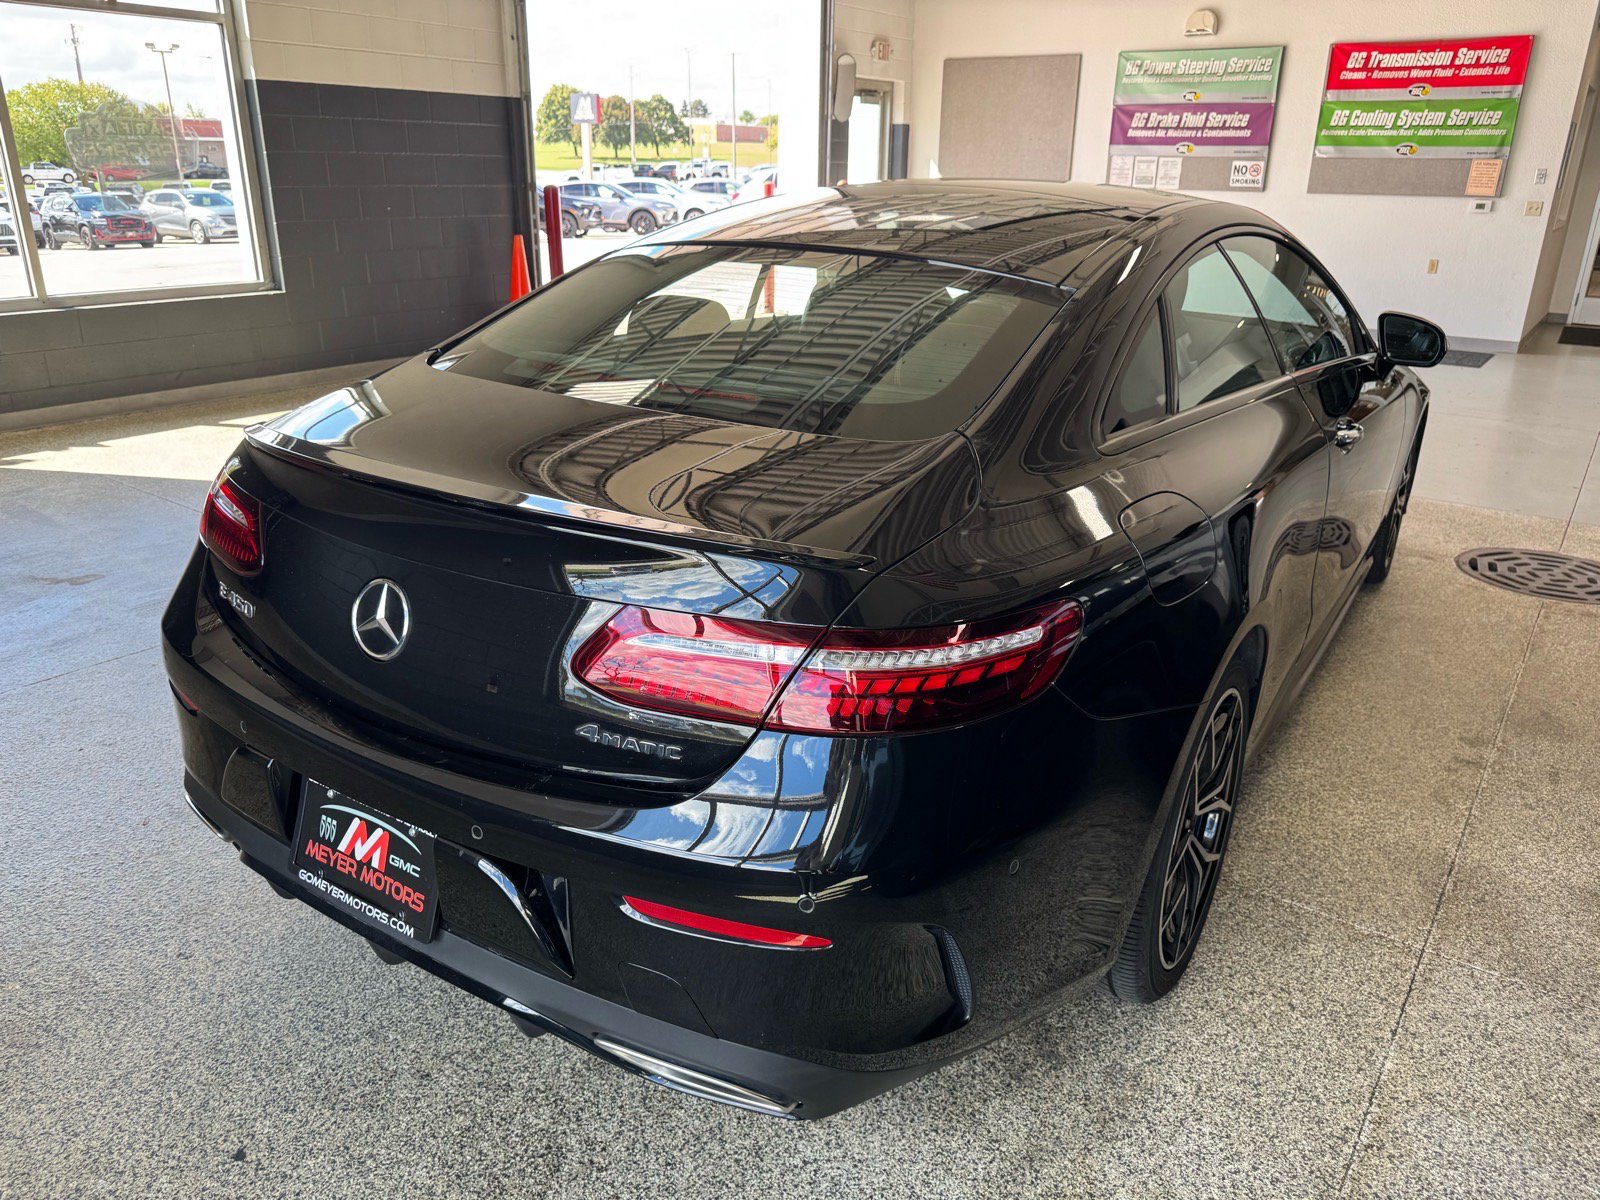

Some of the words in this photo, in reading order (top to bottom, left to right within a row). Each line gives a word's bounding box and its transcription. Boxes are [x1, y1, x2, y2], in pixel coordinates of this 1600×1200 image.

[1125, 60, 1141, 75] BG
[1140, 60, 1176, 75] Power
[1176, 58, 1227, 77] Steering
[1227, 56, 1273, 73] Service
[1346, 51, 1367, 68] BG
[1367, 49, 1454, 68] Transmission
[1454, 46, 1511, 65] Service
[1339, 70, 1367, 79] Cleans
[1371, 69, 1409, 79] Removes
[1409, 68, 1433, 78] Worn
[1432, 67, 1455, 77] Fluid
[1459, 67, 1493, 76] Extends
[1493, 65, 1511, 75] Life
[1131, 112, 1148, 127] BG
[1147, 112, 1180, 127] Brake
[1181, 112, 1206, 127] Fluid
[1206, 111, 1250, 127] Service
[1329, 110, 1350, 126] BG
[1349, 109, 1397, 129] Cooling
[1397, 109, 1447, 129] System
[1447, 108, 1503, 126] Service
[1127, 129, 1155, 137] Removes
[1167, 129, 1196, 137] Moisture
[1202, 129, 1252, 137] Contaminants
[1321, 128, 1348, 136] Removes
[1417, 128, 1434, 136] Adds
[1434, 128, 1464, 136] Premium
[1464, 128, 1506, 136] Conditioners
[1233, 165, 1248, 176] NO
[575, 723, 683, 760] 4MATIC
[305, 839, 358, 879] MEYER
[359, 865, 425, 913] MOTORS
[389, 854, 421, 878] GMC
[298, 868, 415, 939] GOMEYERMOTORS.COM
